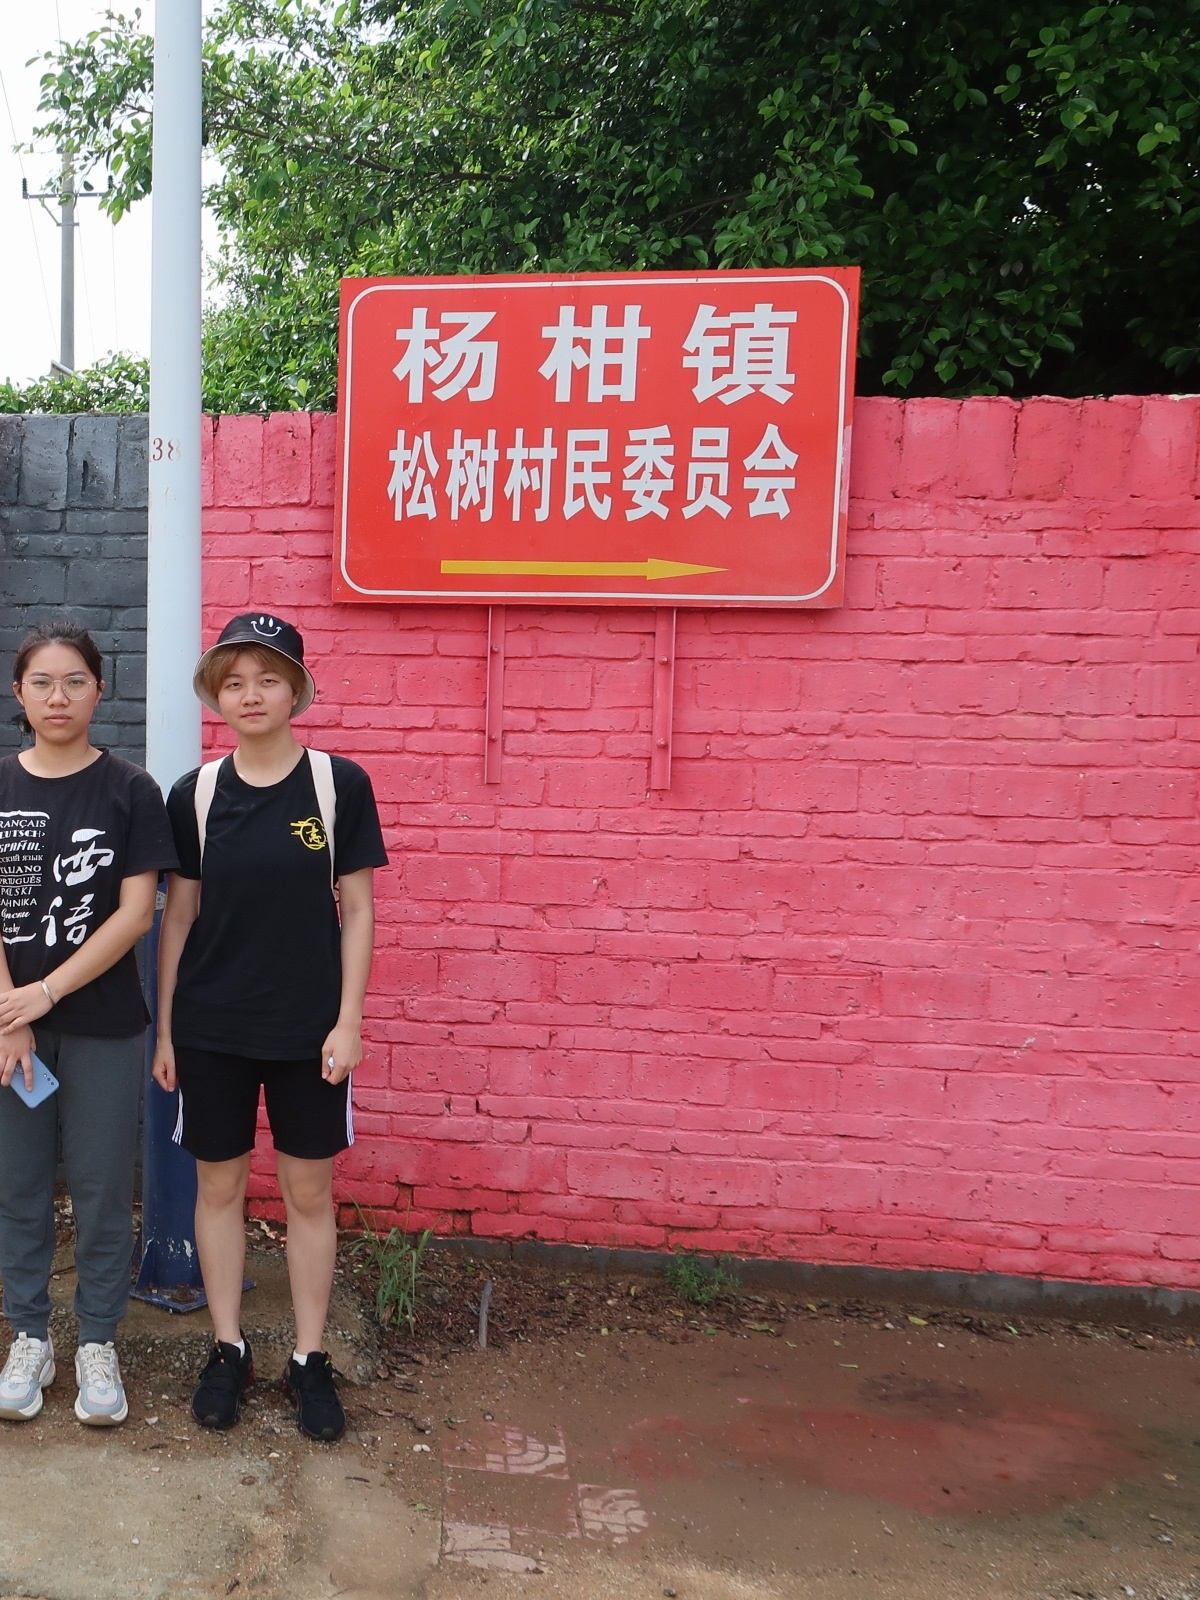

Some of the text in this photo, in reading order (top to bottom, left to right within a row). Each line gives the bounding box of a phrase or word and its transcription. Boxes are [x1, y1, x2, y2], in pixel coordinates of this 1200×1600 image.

[392, 303, 798, 405] 杨柑镇
[386, 422, 799, 523] 松树村民委员会
